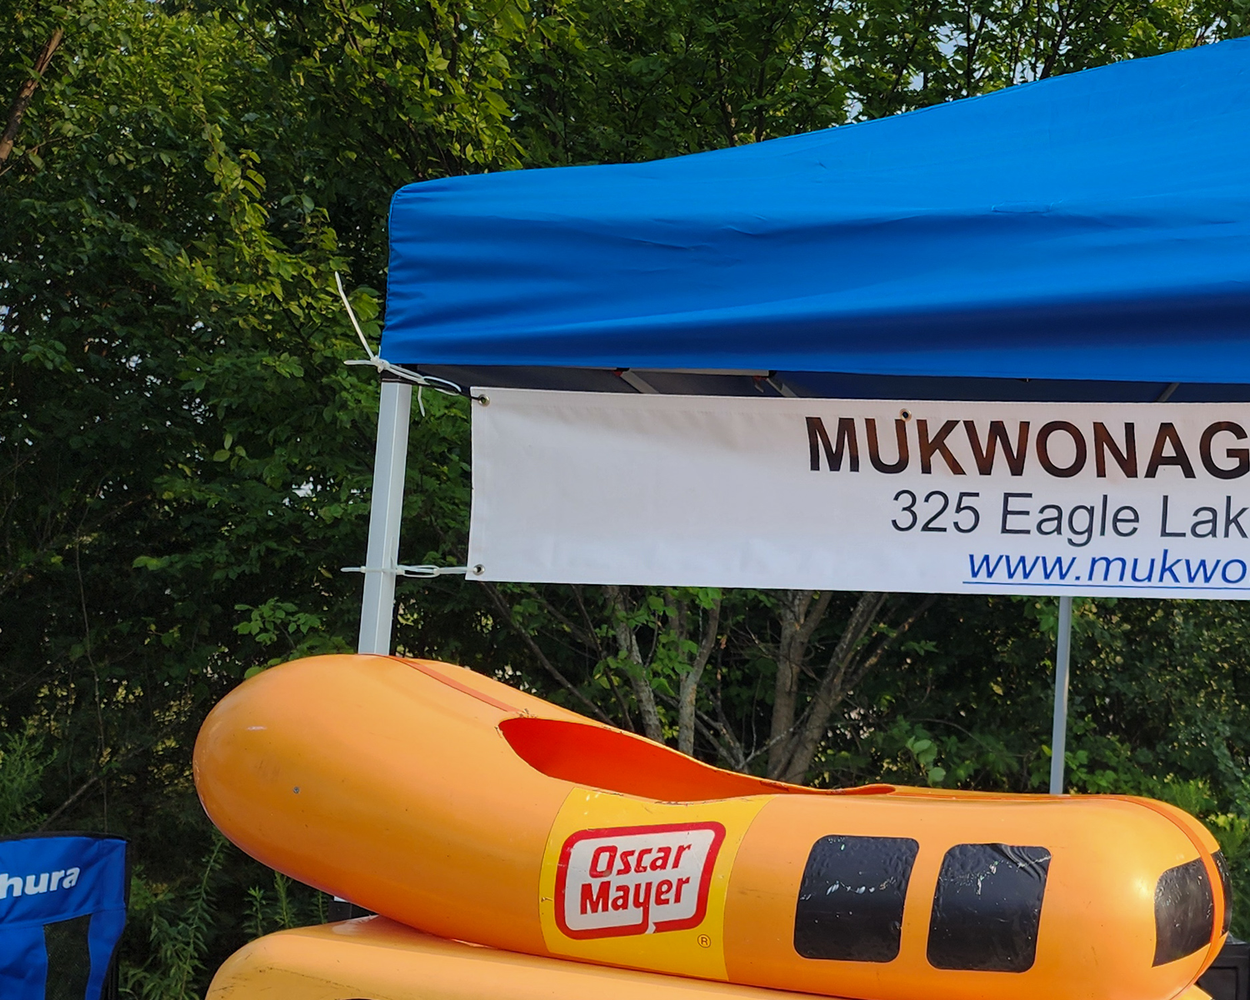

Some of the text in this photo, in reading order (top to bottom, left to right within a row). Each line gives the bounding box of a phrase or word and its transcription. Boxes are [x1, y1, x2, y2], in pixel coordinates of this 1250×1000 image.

[891, 489, 981, 534] 325
[1000, 492, 1141, 547] Eagle
[589, 844, 692, 878] Oscar
[580, 877, 690, 925] Mayer
